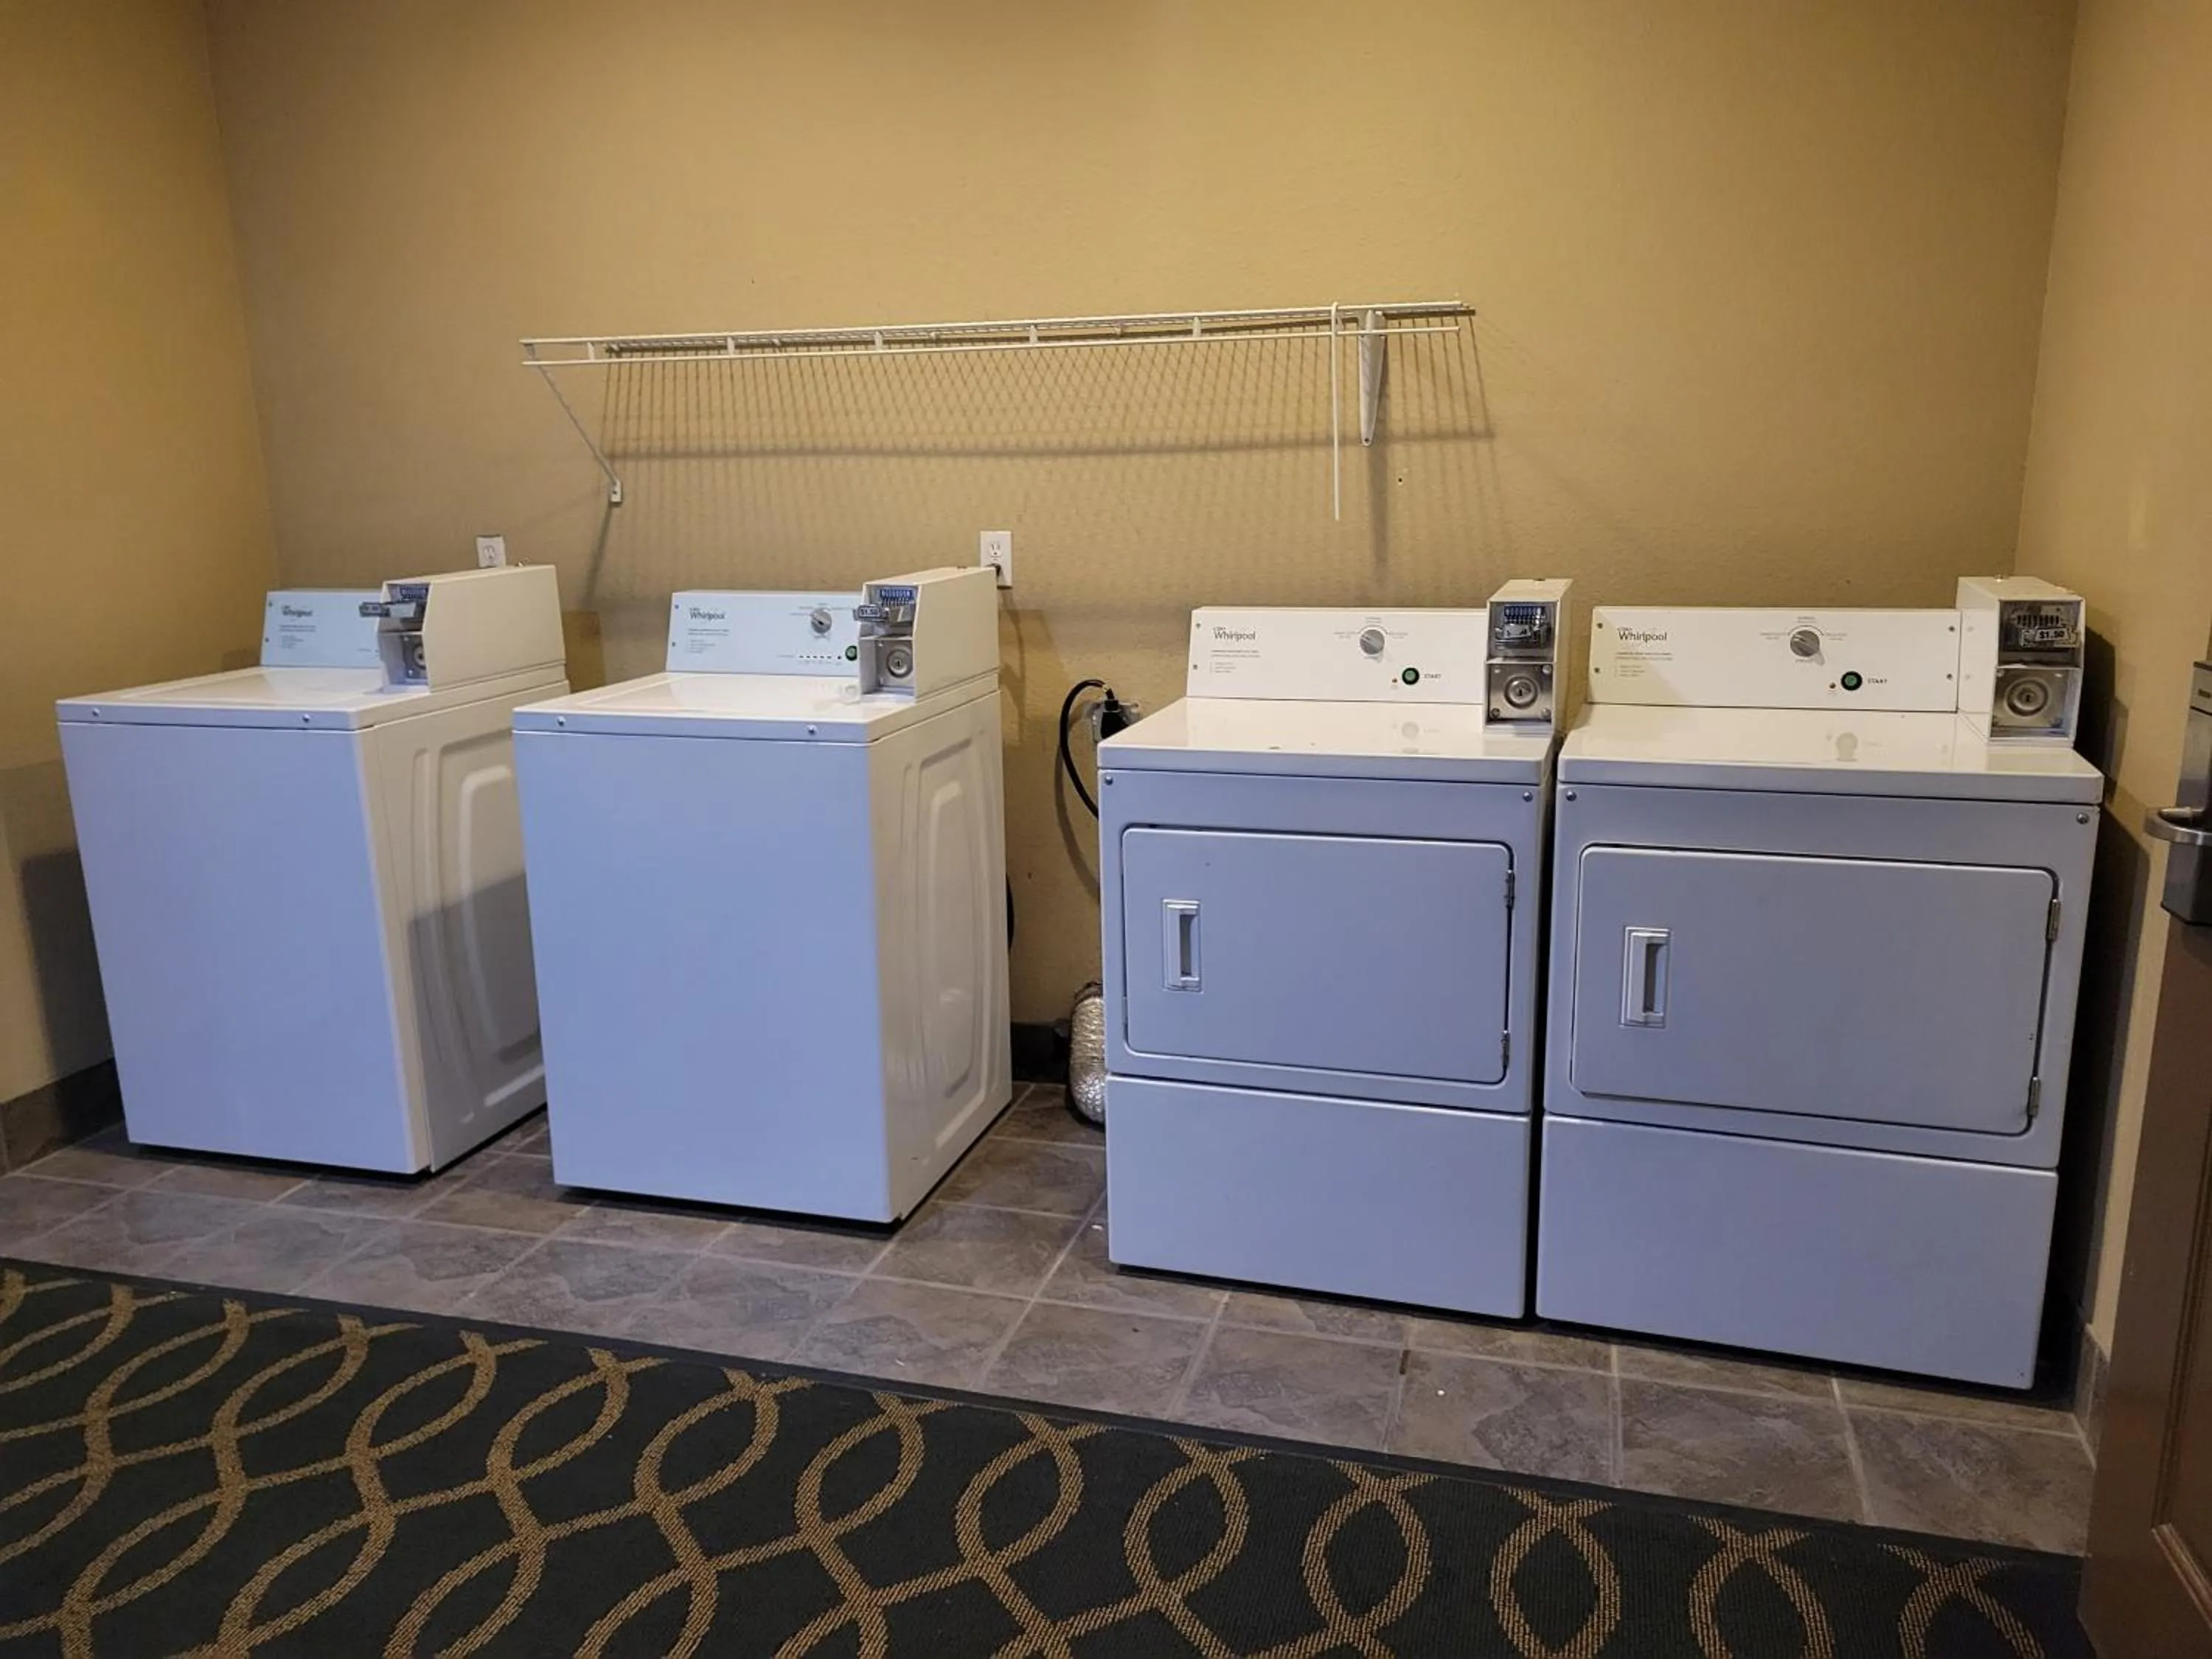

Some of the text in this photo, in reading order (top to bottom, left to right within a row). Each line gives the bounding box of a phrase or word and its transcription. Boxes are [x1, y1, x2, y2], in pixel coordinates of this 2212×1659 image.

[690, 611, 725, 621] Whirlpool
[1214, 630, 1255, 641] Whirlpool
[1618, 631, 1667, 643] Whirlpool
[2039, 630, 2065, 639] $1.50
